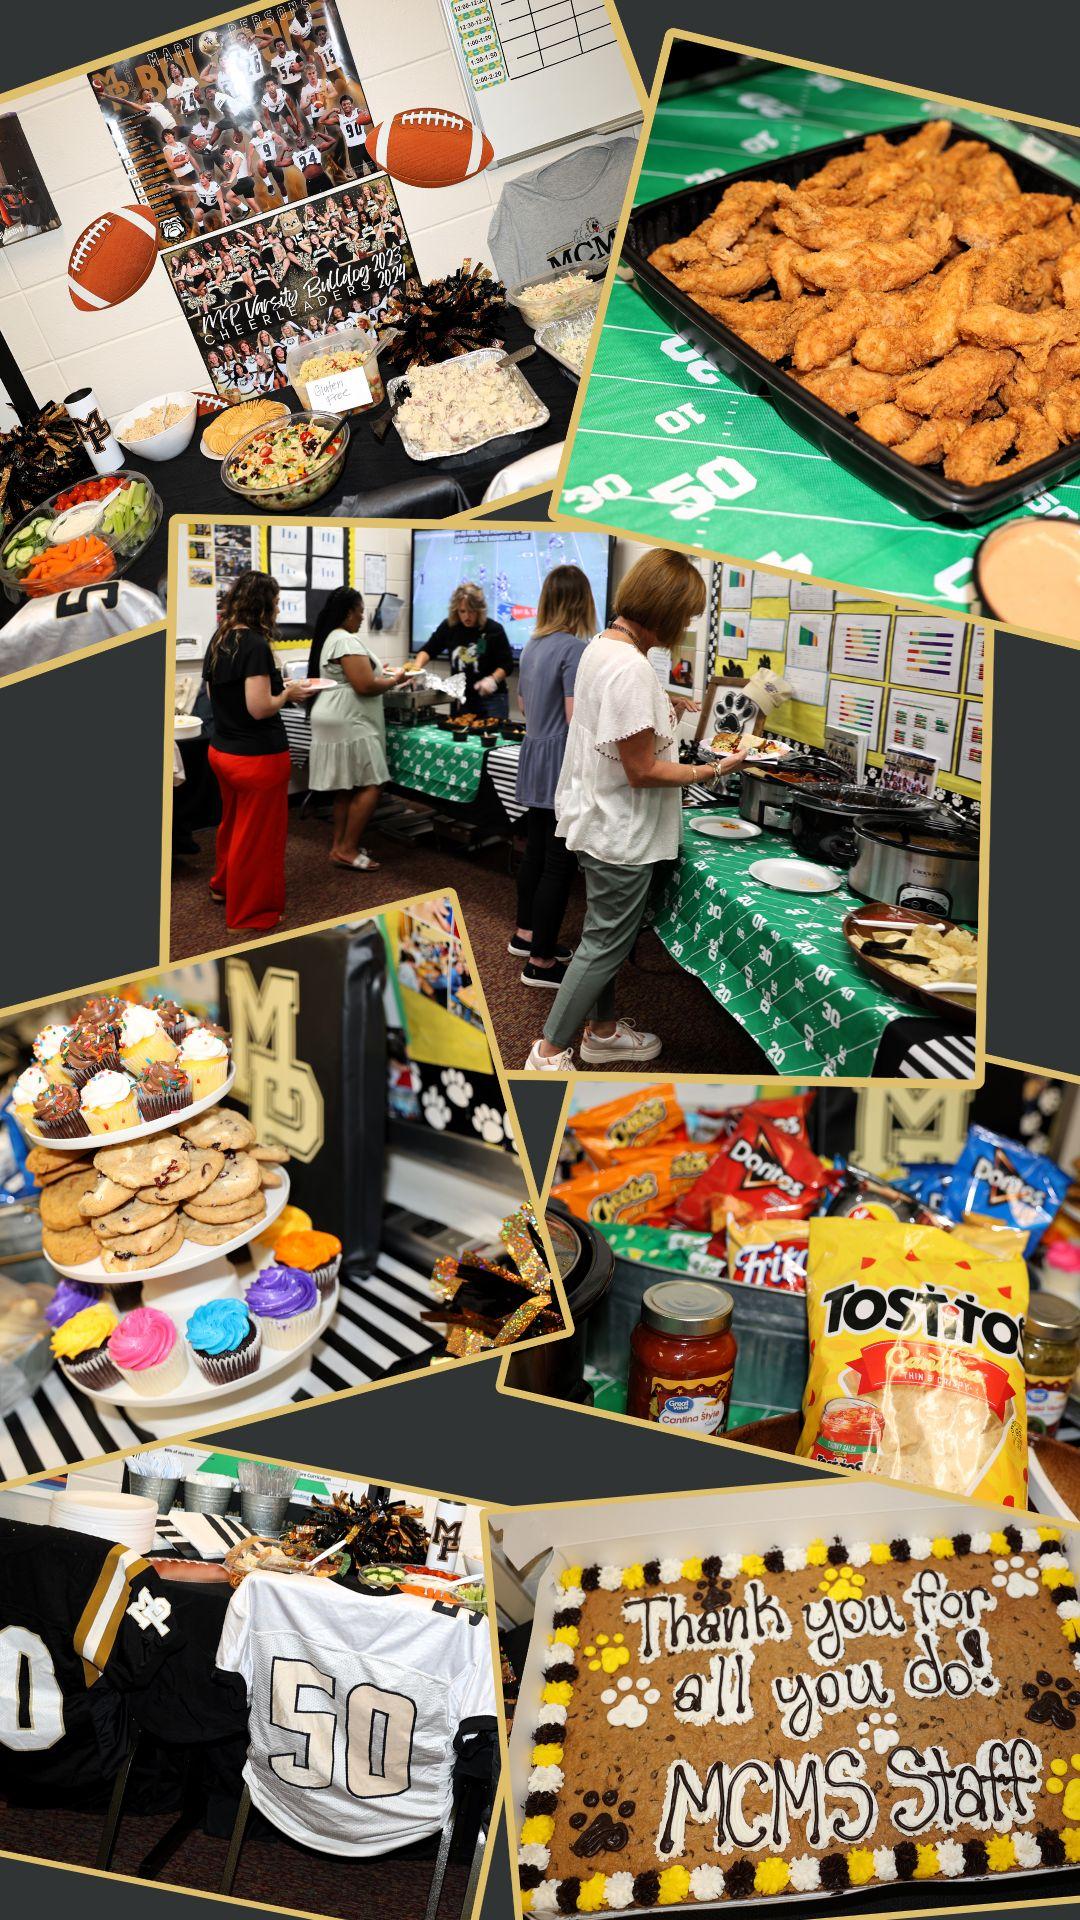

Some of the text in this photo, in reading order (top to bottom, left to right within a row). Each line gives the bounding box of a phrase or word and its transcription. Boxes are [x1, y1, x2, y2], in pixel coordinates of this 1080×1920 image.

[147, 37, 194, 68] MARY
[467, 34, 492, 48] 1:00-1:20
[475, 70, 502, 85] 2:00-2:20
[262, 143, 272, 158] 9
[297, 151, 318, 170] 94
[202, 246, 402, 334] MP Varsity Bulldog 2023
[378, 263, 406, 289] 2024
[204, 282, 371, 346] CHEERLEADERS
[564, 473, 633, 514] 30
[647, 456, 758, 521] 50
[706, 901, 722, 920] 30
[671, 940, 684, 958] 20
[714, 983, 732, 1004] 20
[840, 986, 856, 1002] 40
[821, 1001, 841, 1030] 30
[766, 1041, 786, 1066] 20
[729, 1138, 804, 1198] Doritos
[972, 1156, 1047, 1208] Doritos
[590, 1172, 657, 1224] Cheetos
[662, 1409, 720, 1425] Cantina Style
[668, 1400, 689, 1408] Great
[621, 1568, 993, 1660] Thank you for
[673, 1628, 996, 1736] all you do!
[267, 1655, 419, 1800] 50
[659, 1737, 1040, 1855] MCMS Staff
